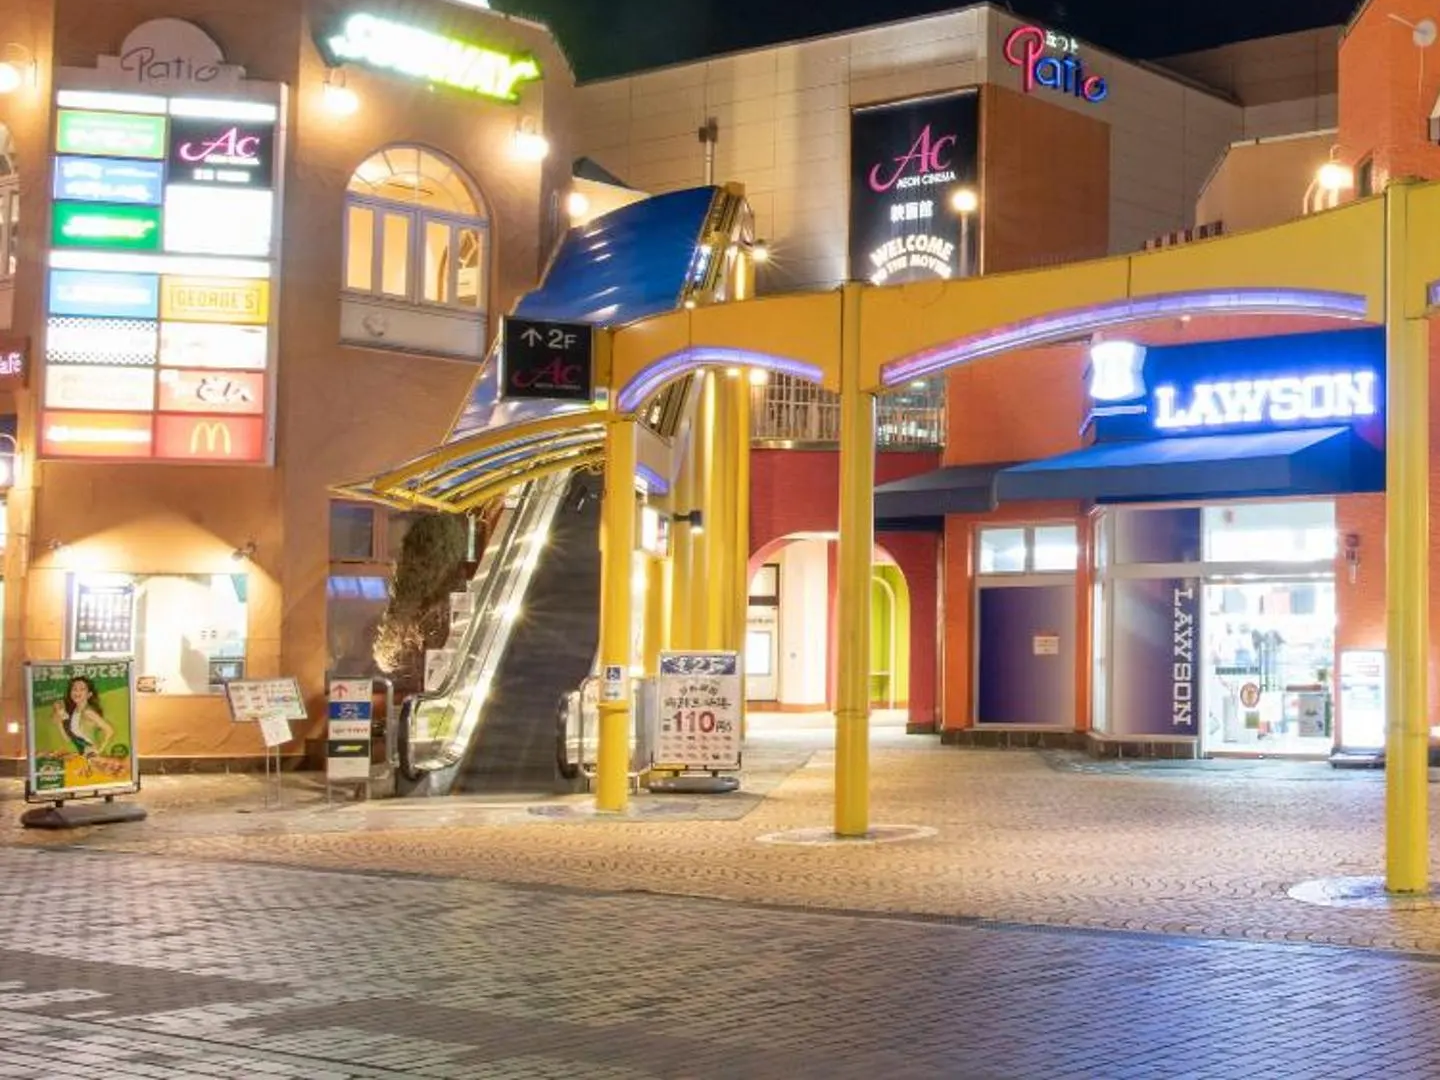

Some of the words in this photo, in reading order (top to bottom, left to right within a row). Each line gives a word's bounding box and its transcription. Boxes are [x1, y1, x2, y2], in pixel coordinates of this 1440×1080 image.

[121, 46, 219, 84] Patio
[1003, 25, 1107, 103] Patio
[869, 234, 955, 267] WELCOME
[547, 328, 577, 349] 2F
[1154, 371, 1376, 428] LAWSON
[1172, 588, 1194, 726] LAWSON
